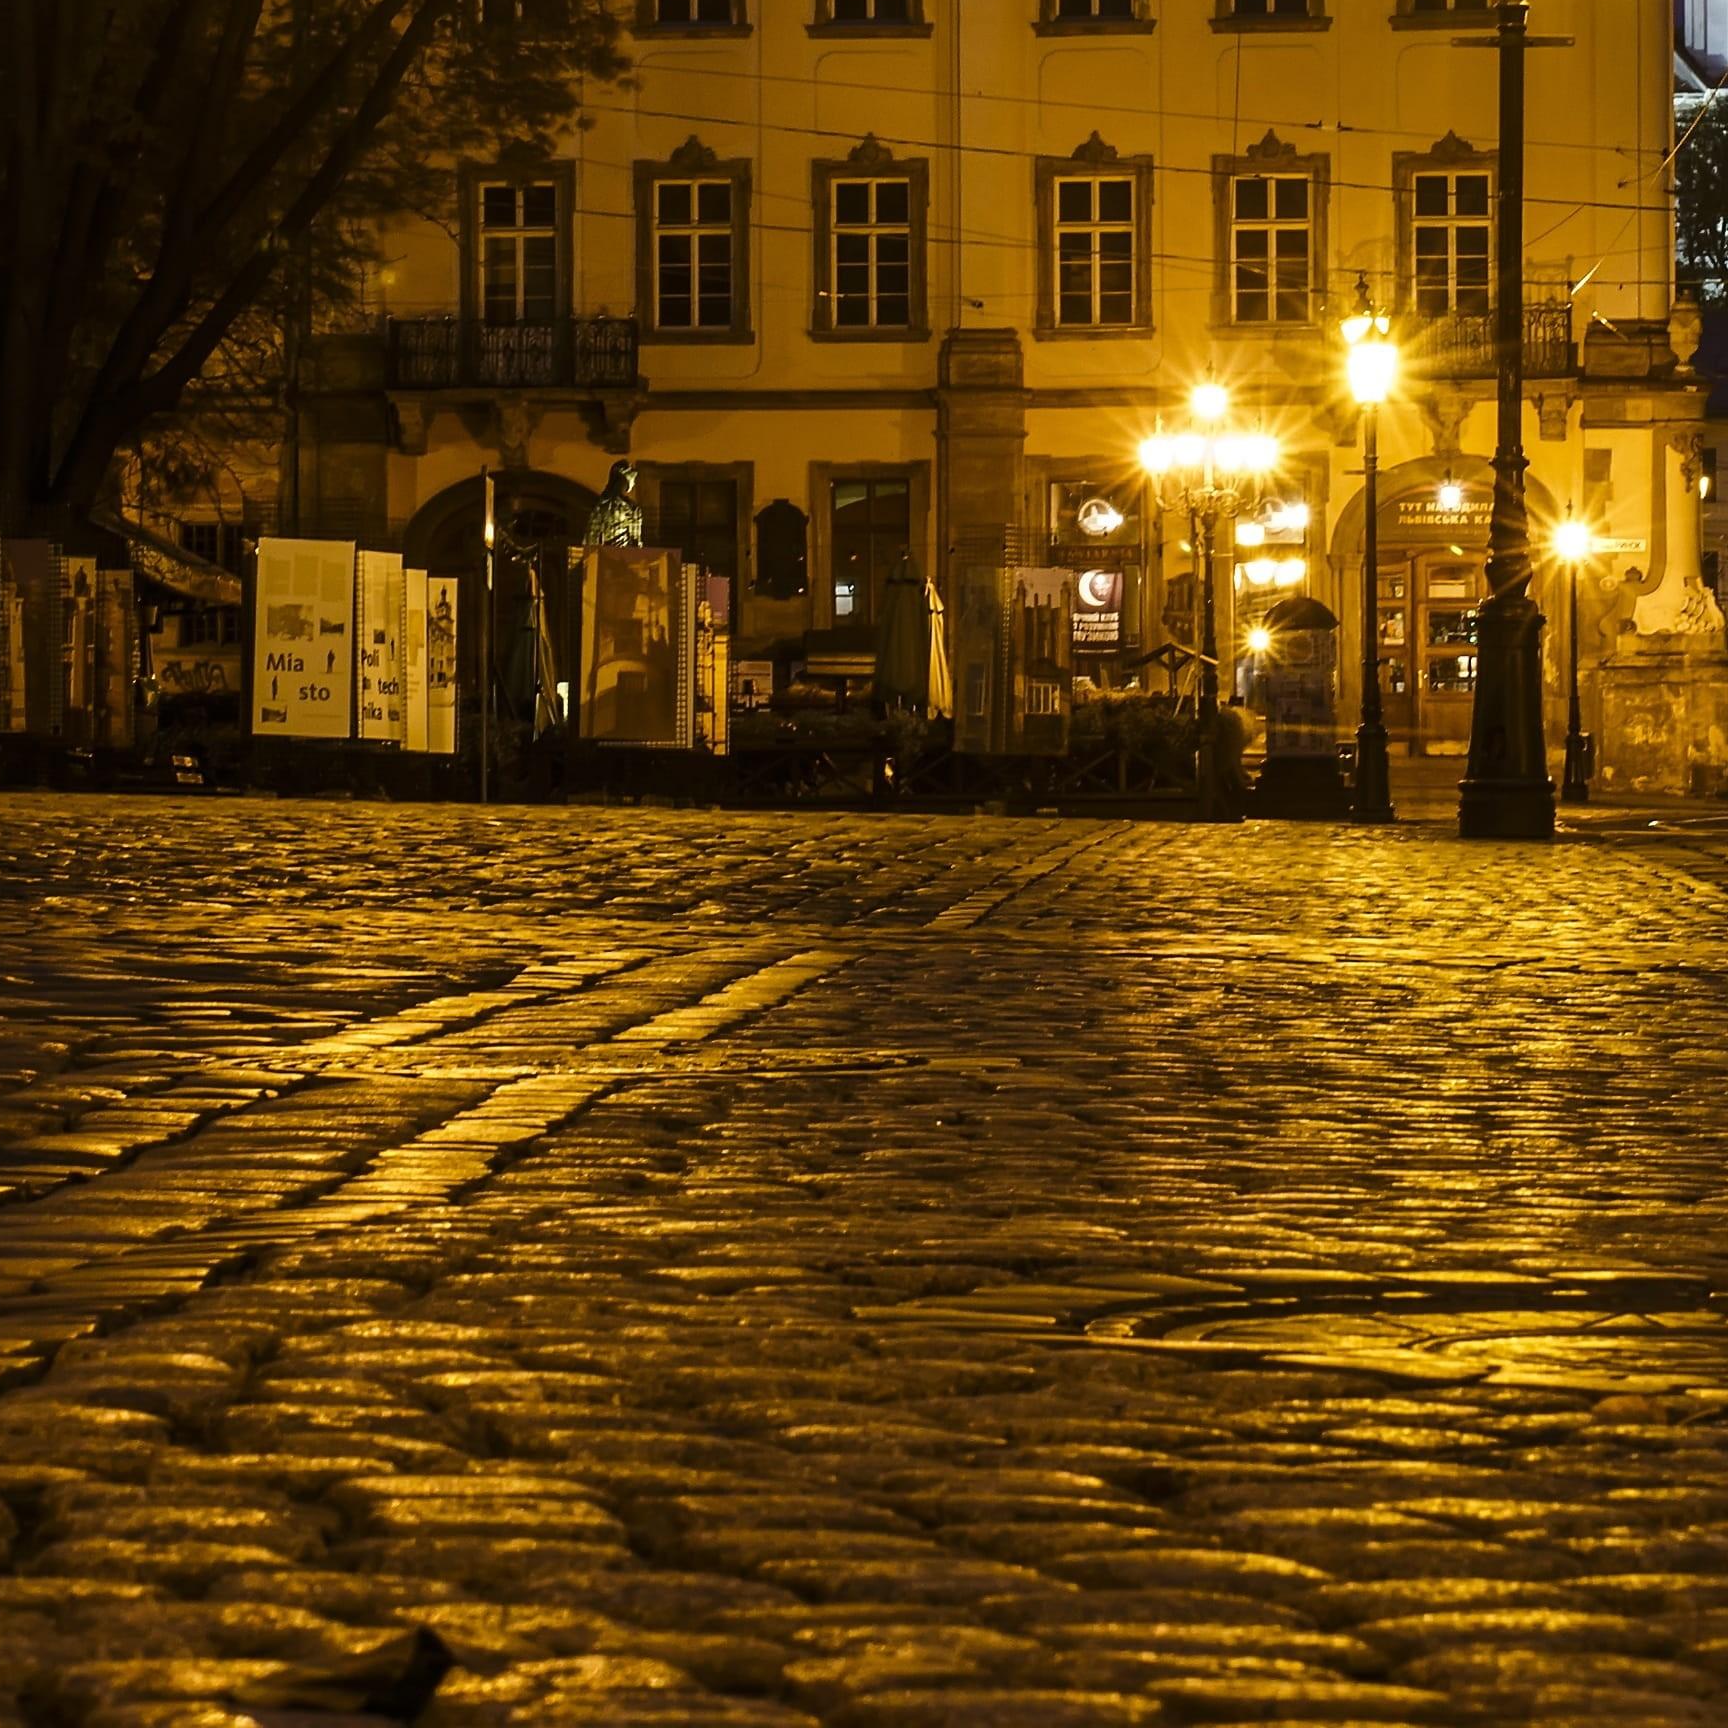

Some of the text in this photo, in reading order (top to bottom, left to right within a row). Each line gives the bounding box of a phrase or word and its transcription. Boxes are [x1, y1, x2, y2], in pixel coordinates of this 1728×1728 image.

[1399, 502, 1422, 512] ТУТ
[1398, 515, 1468, 525] ЛЬВІВСЬКА
[266, 653, 304, 672] Mia
[299, 681, 330, 701] sto
[378, 676, 399, 696] tech
